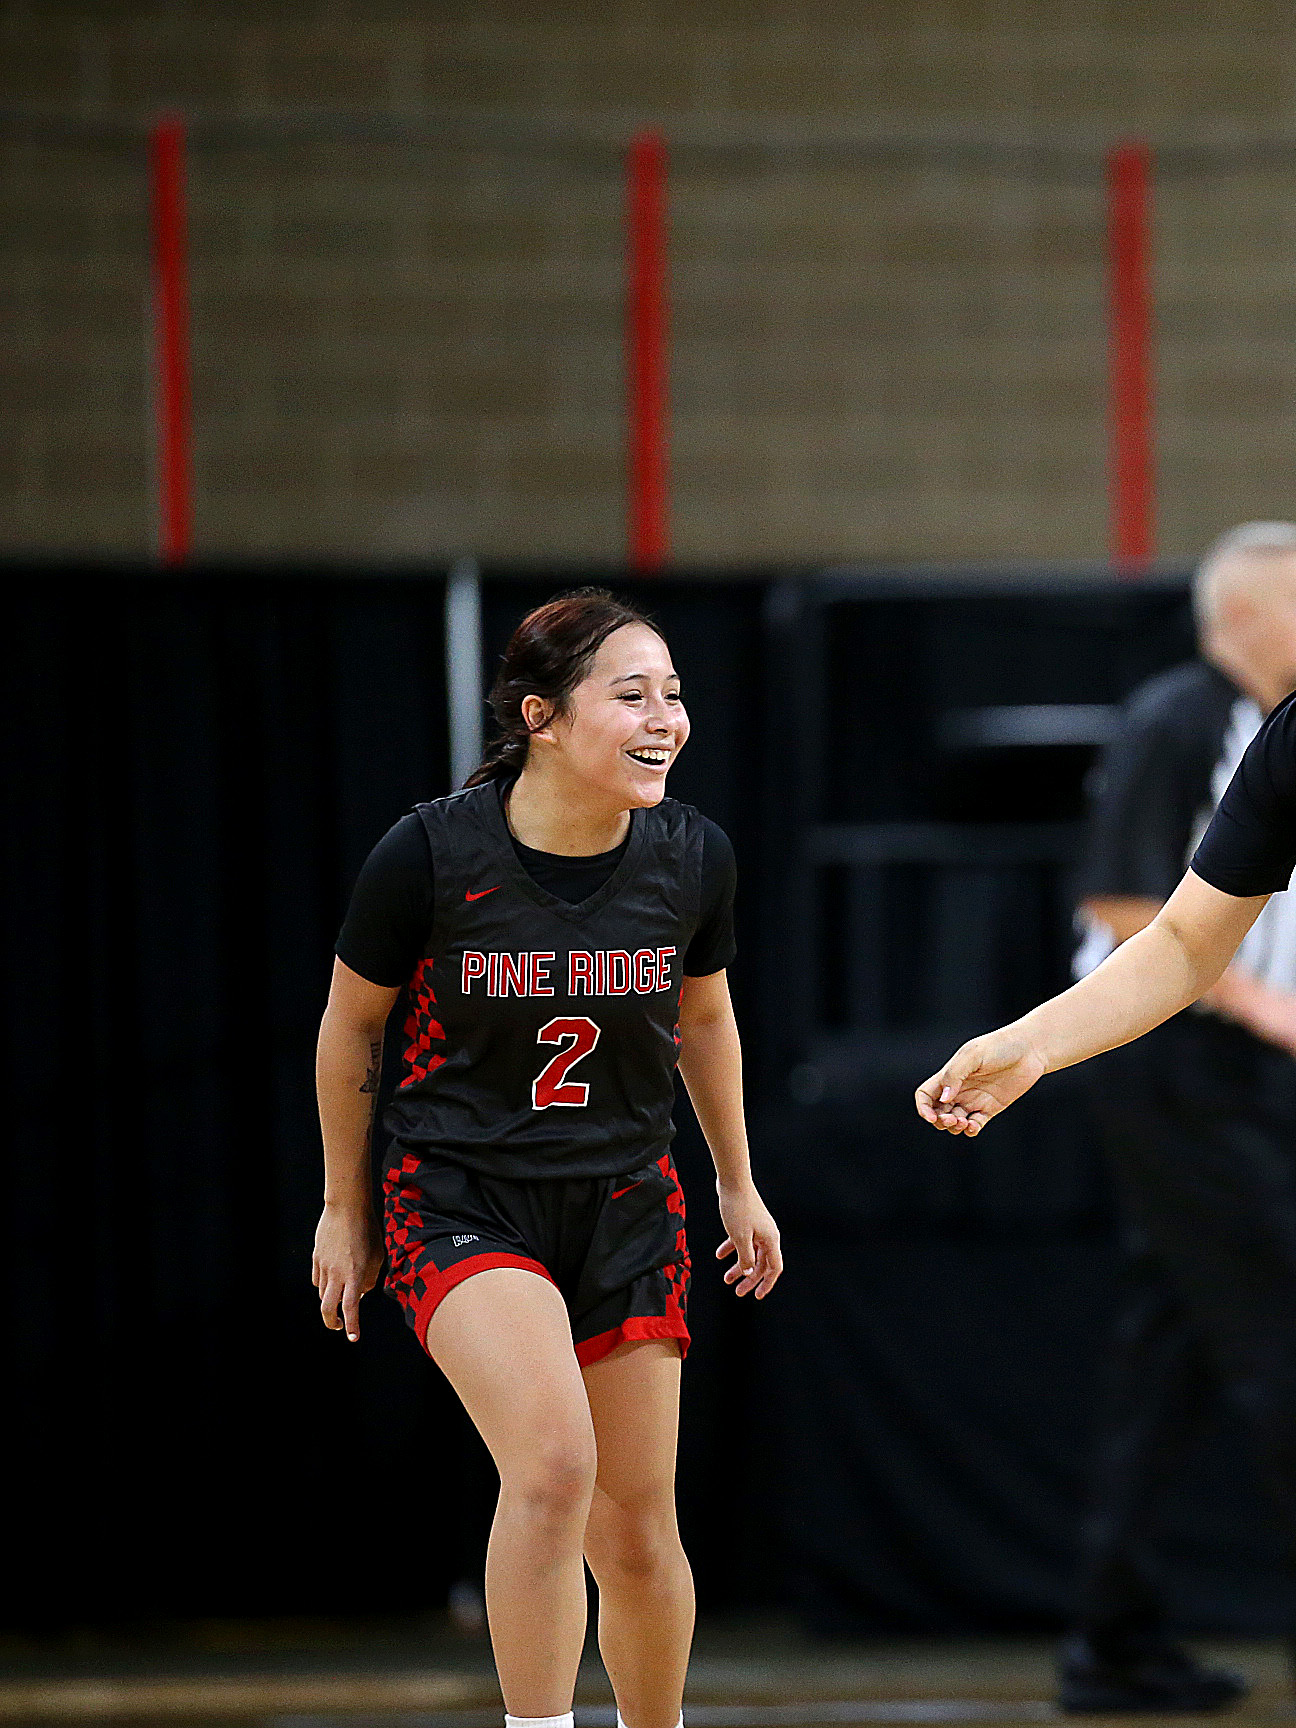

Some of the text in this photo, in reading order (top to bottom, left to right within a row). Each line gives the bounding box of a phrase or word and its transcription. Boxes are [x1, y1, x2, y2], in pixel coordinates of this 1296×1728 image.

[462, 946, 676, 997] PINE RIDGE
[532, 1016, 601, 1110] 2
